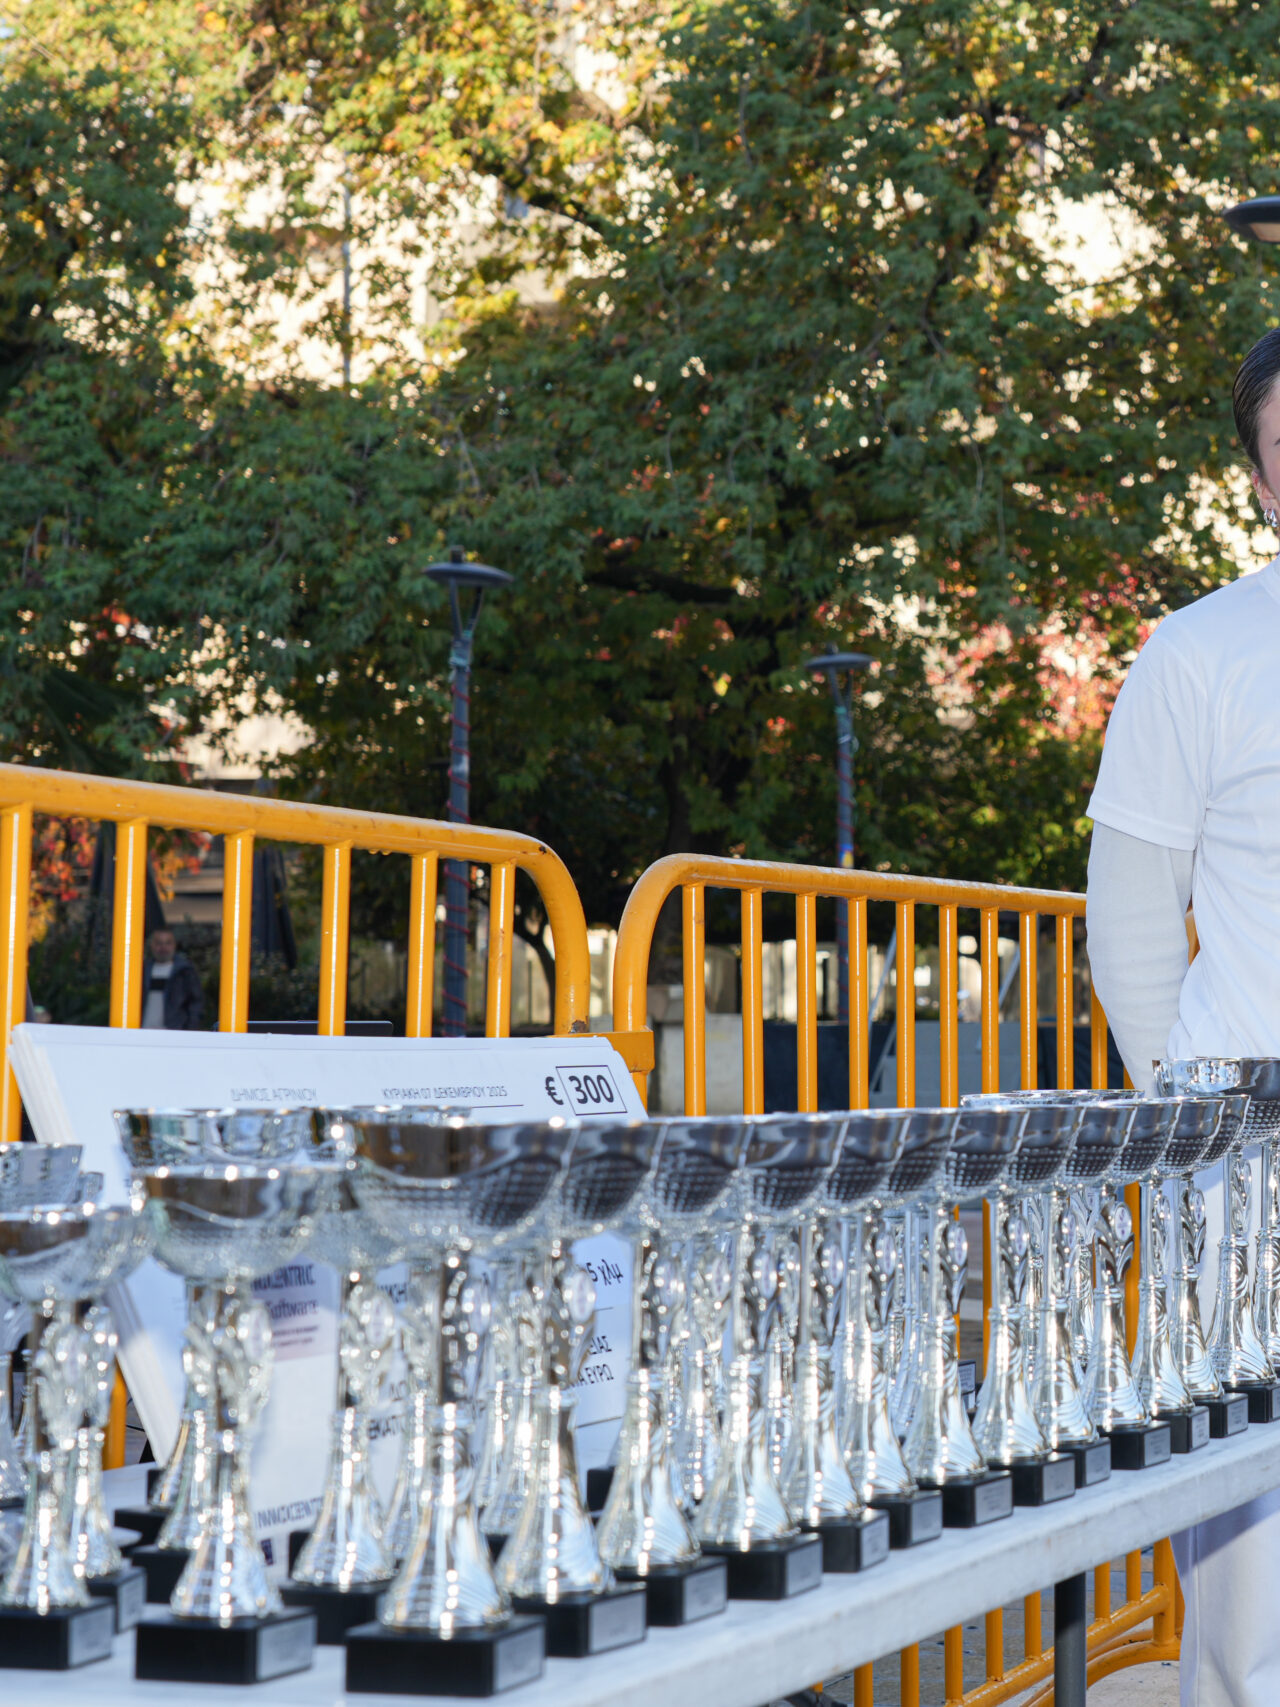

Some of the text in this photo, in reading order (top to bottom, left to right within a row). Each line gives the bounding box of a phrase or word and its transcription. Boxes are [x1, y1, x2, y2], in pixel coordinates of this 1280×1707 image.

[381, 1085, 508, 1100] ΚΥΡΙΑΚΗ 07 ΔΕΚΕΜΒΡΙΟΥ 2025
[545, 1073, 614, 1106] € 300
[589, 1363, 614, 1385] ΕΥΡΩ
